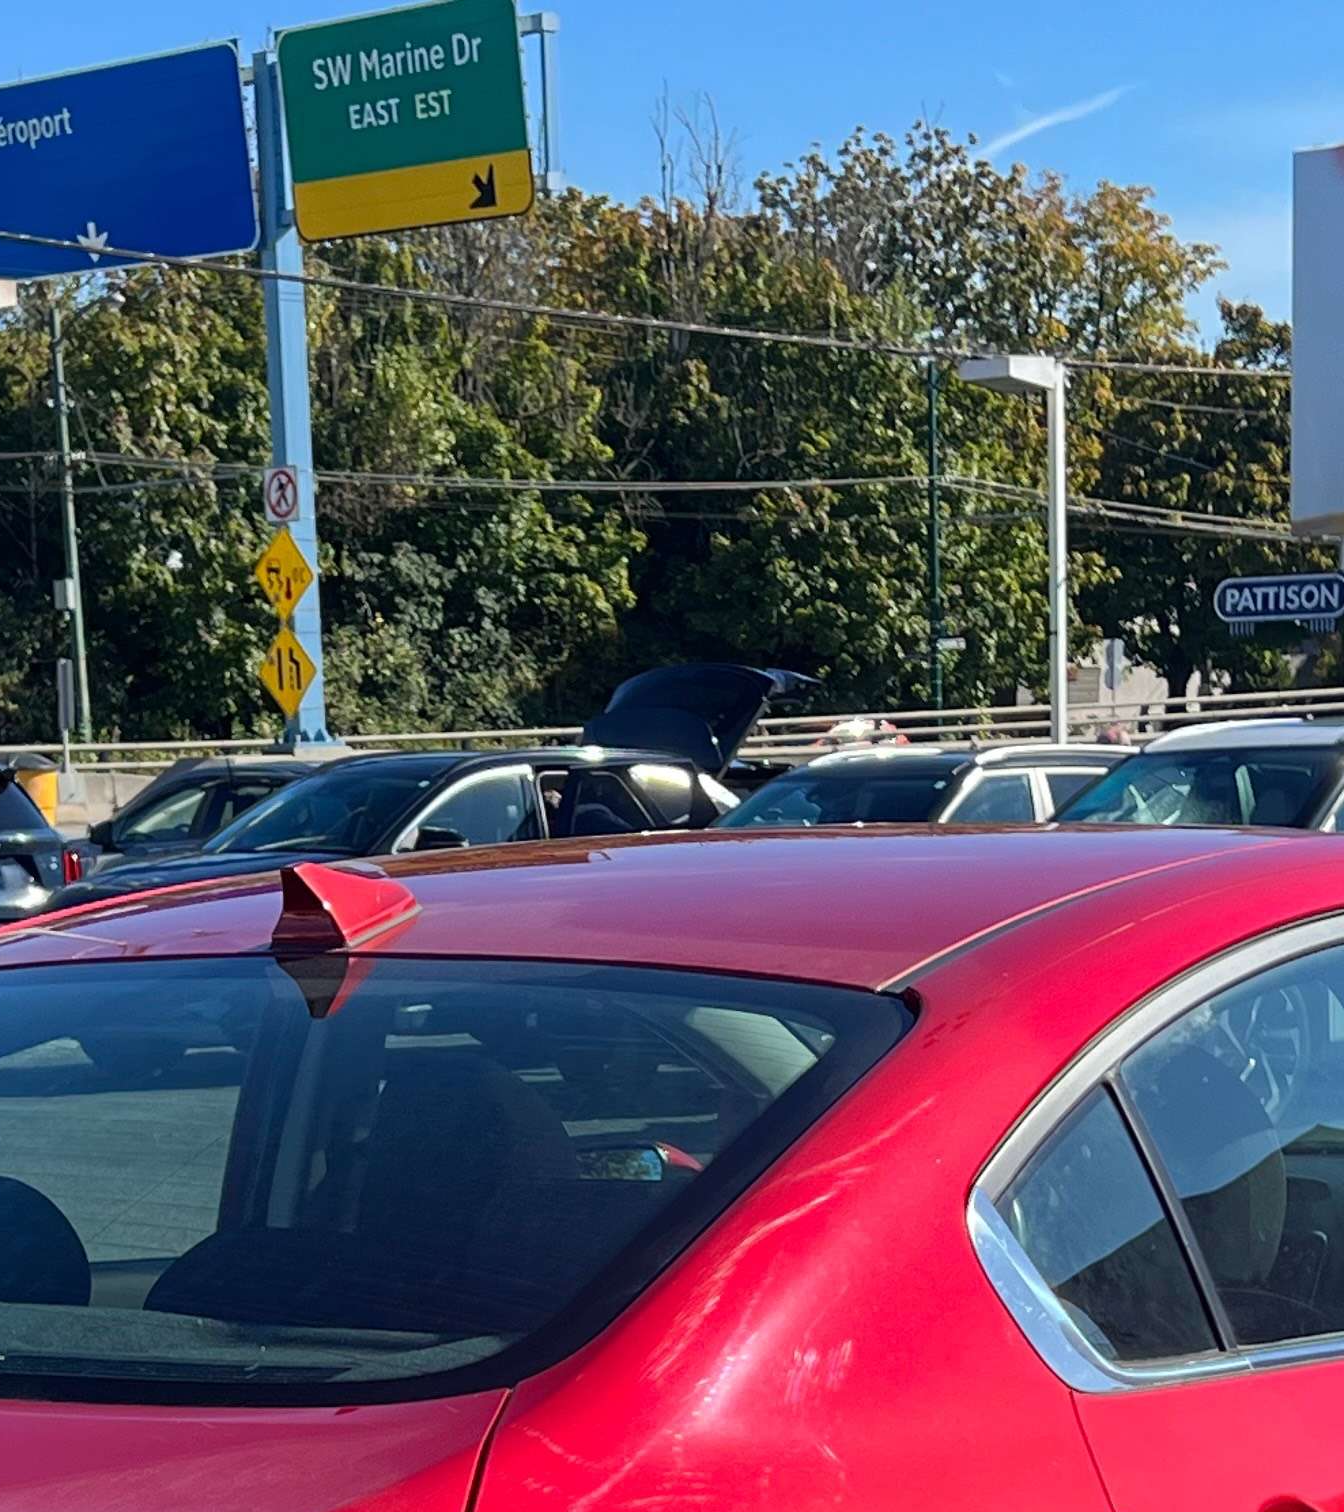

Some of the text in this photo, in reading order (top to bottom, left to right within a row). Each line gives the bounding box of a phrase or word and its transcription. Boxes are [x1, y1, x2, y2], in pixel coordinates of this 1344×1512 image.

[312, 32, 483, 91] SW Marine Dr
[348, 89, 452, 130] EAST EST
[1225, 582, 1340, 613] PATTISON
